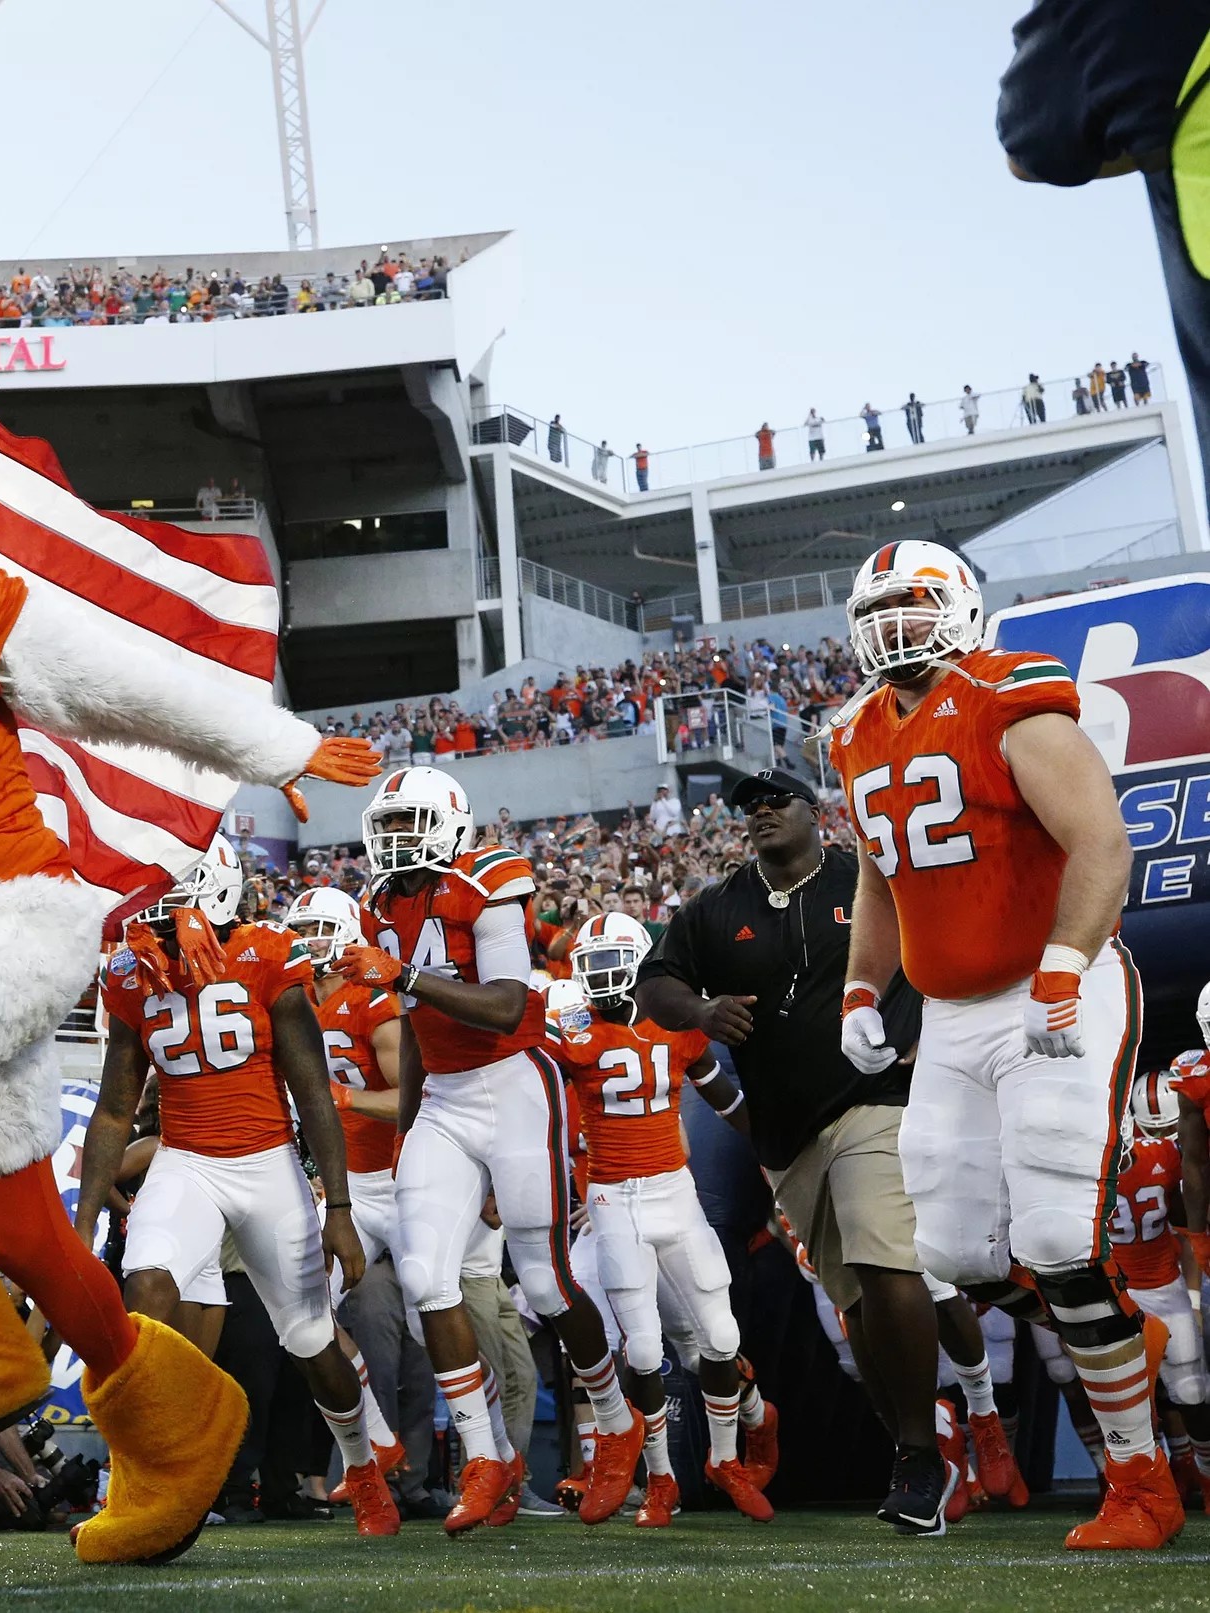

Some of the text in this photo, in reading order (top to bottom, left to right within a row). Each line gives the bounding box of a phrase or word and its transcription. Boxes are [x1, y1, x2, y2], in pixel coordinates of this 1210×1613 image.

[932, 707, 959, 719] adidas
[853, 753, 978, 878] 52
[143, 982, 255, 1077] 26
[597, 1044, 672, 1117] 21
